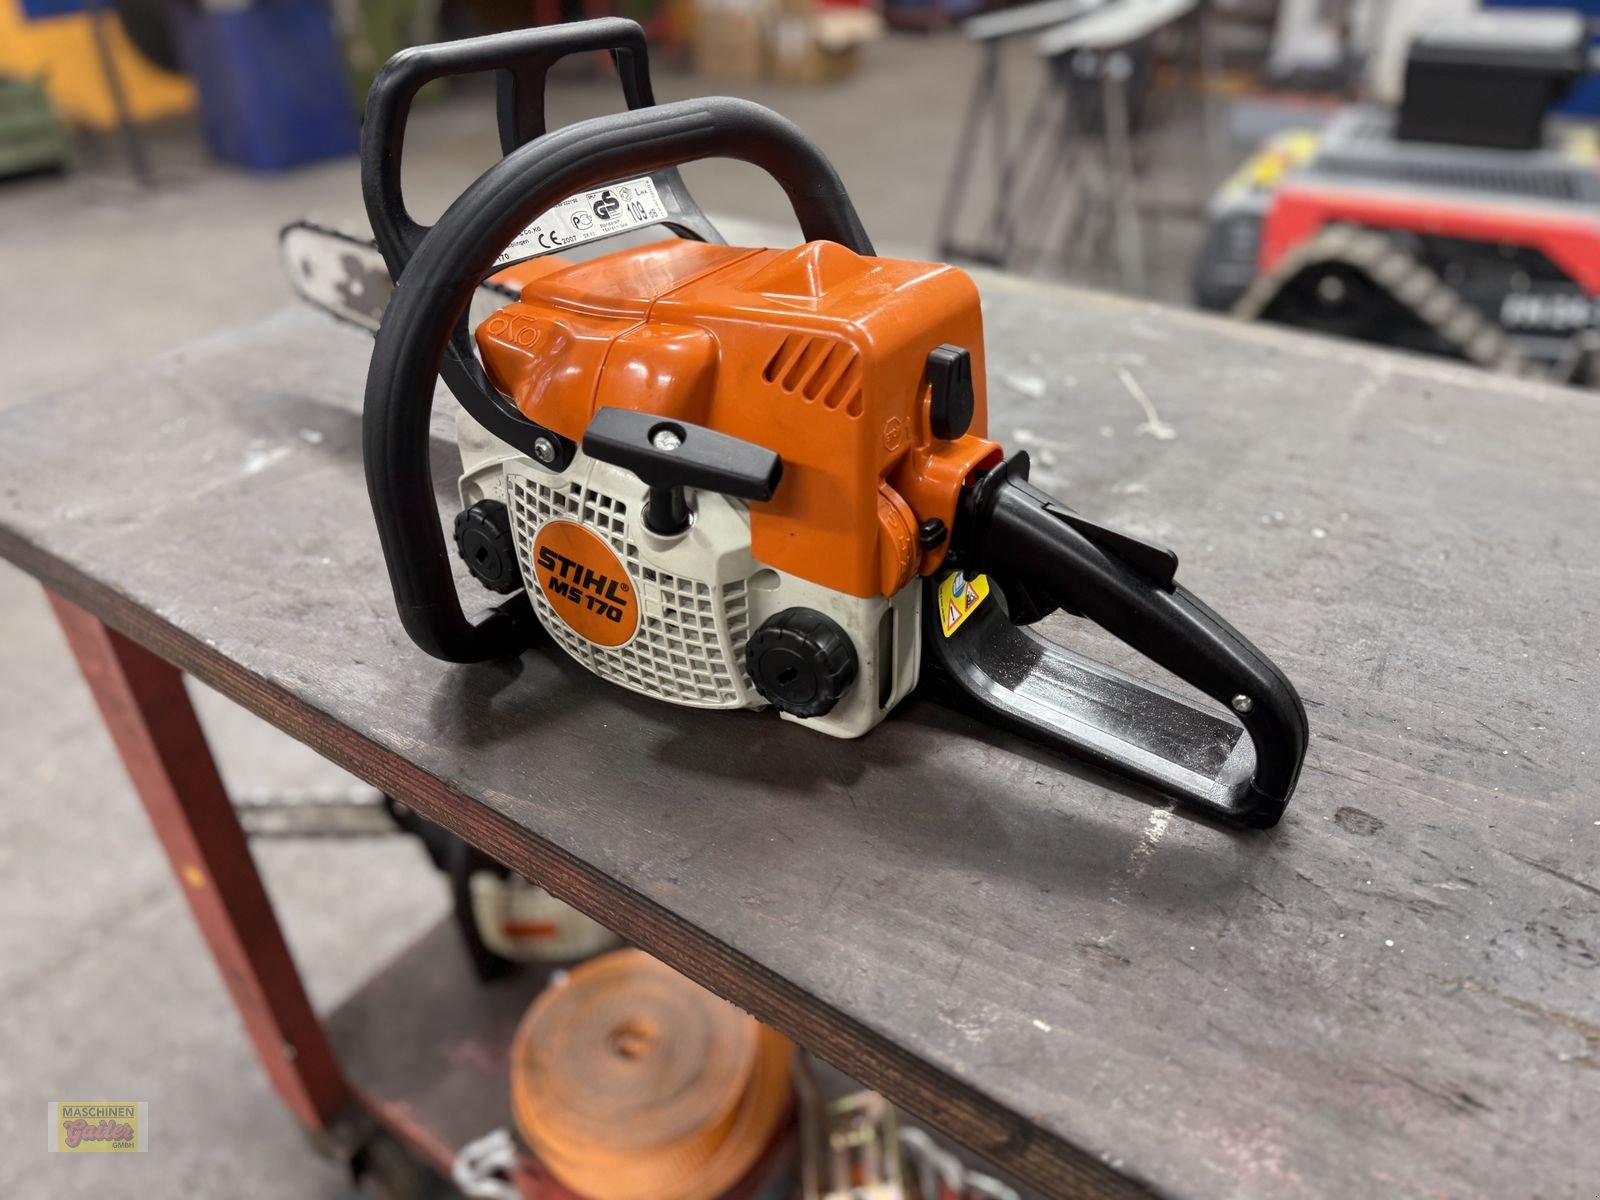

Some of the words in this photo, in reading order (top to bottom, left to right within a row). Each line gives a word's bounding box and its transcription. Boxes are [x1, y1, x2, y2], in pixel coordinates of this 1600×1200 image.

[627, 201, 648, 223] 109
[538, 230, 562, 248] CE
[562, 235, 577, 245] 2007
[548, 576, 583, 604] MS
[585, 594, 623, 623] 170
